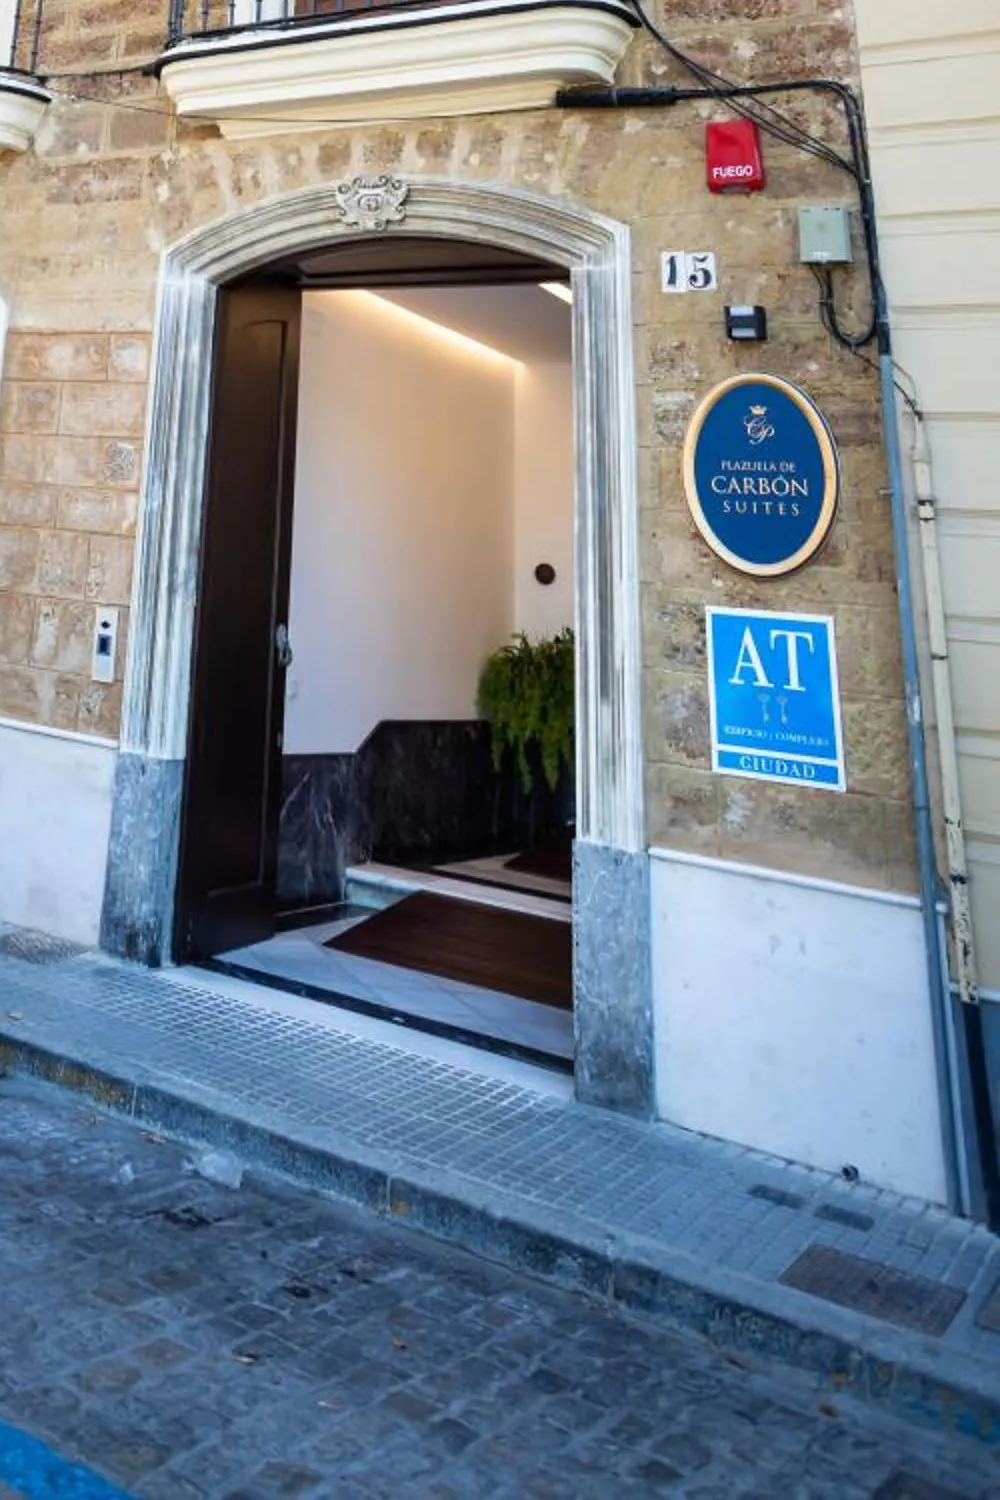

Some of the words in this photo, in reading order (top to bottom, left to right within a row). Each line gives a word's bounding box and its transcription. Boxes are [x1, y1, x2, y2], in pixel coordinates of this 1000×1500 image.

[712, 165, 753, 179] FUEGO
[667, 255, 712, 289] 15
[779, 461, 796, 473] DE
[711, 474, 808, 497] CARBÓN
[722, 500, 799, 516] SUITES
[728, 625, 815, 692] AT
[739, 755, 816, 779] CIUDAD
